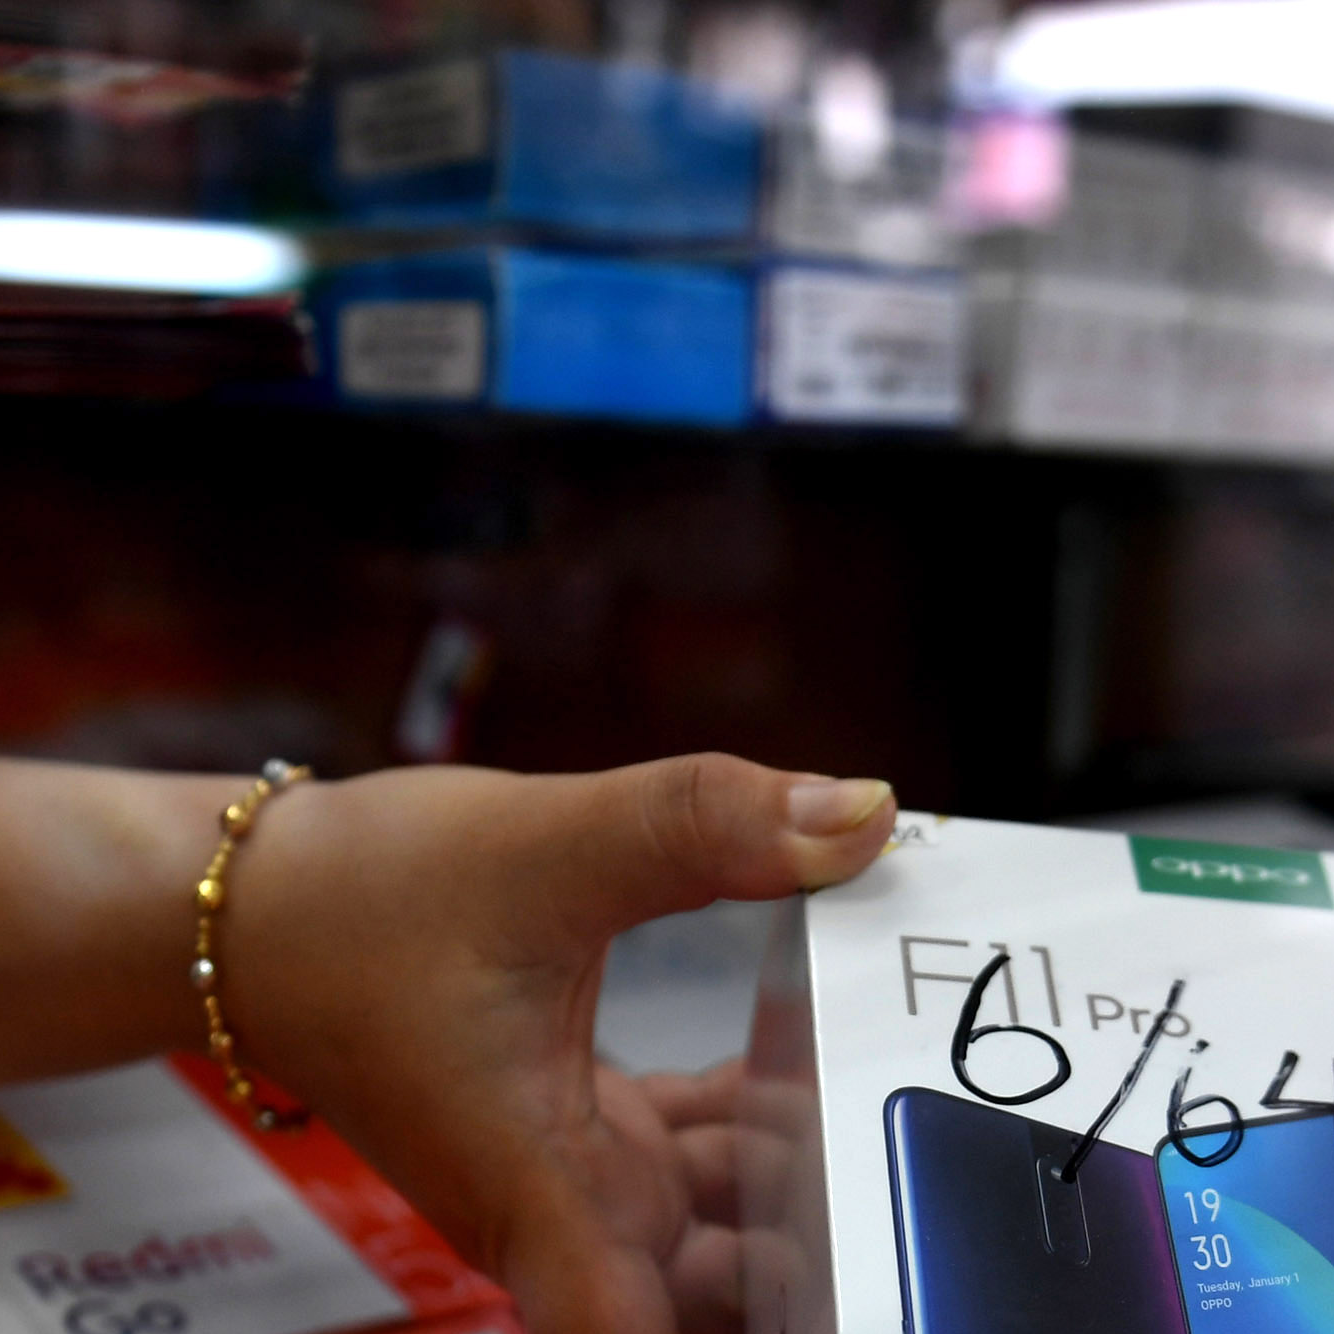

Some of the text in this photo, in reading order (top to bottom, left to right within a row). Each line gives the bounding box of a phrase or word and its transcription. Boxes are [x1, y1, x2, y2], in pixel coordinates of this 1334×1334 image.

[1150, 853, 1312, 887] oppo
[898, 934, 1195, 1042] F11 Pro
[1183, 1187, 1221, 1225] 19
[17, 1222, 279, 1300] Redmi
[1190, 1233, 1233, 1271] 30
[1197, 1272, 1301, 1295] Tuesday, January 1
[1200, 1297, 1233, 1312] OPPO
